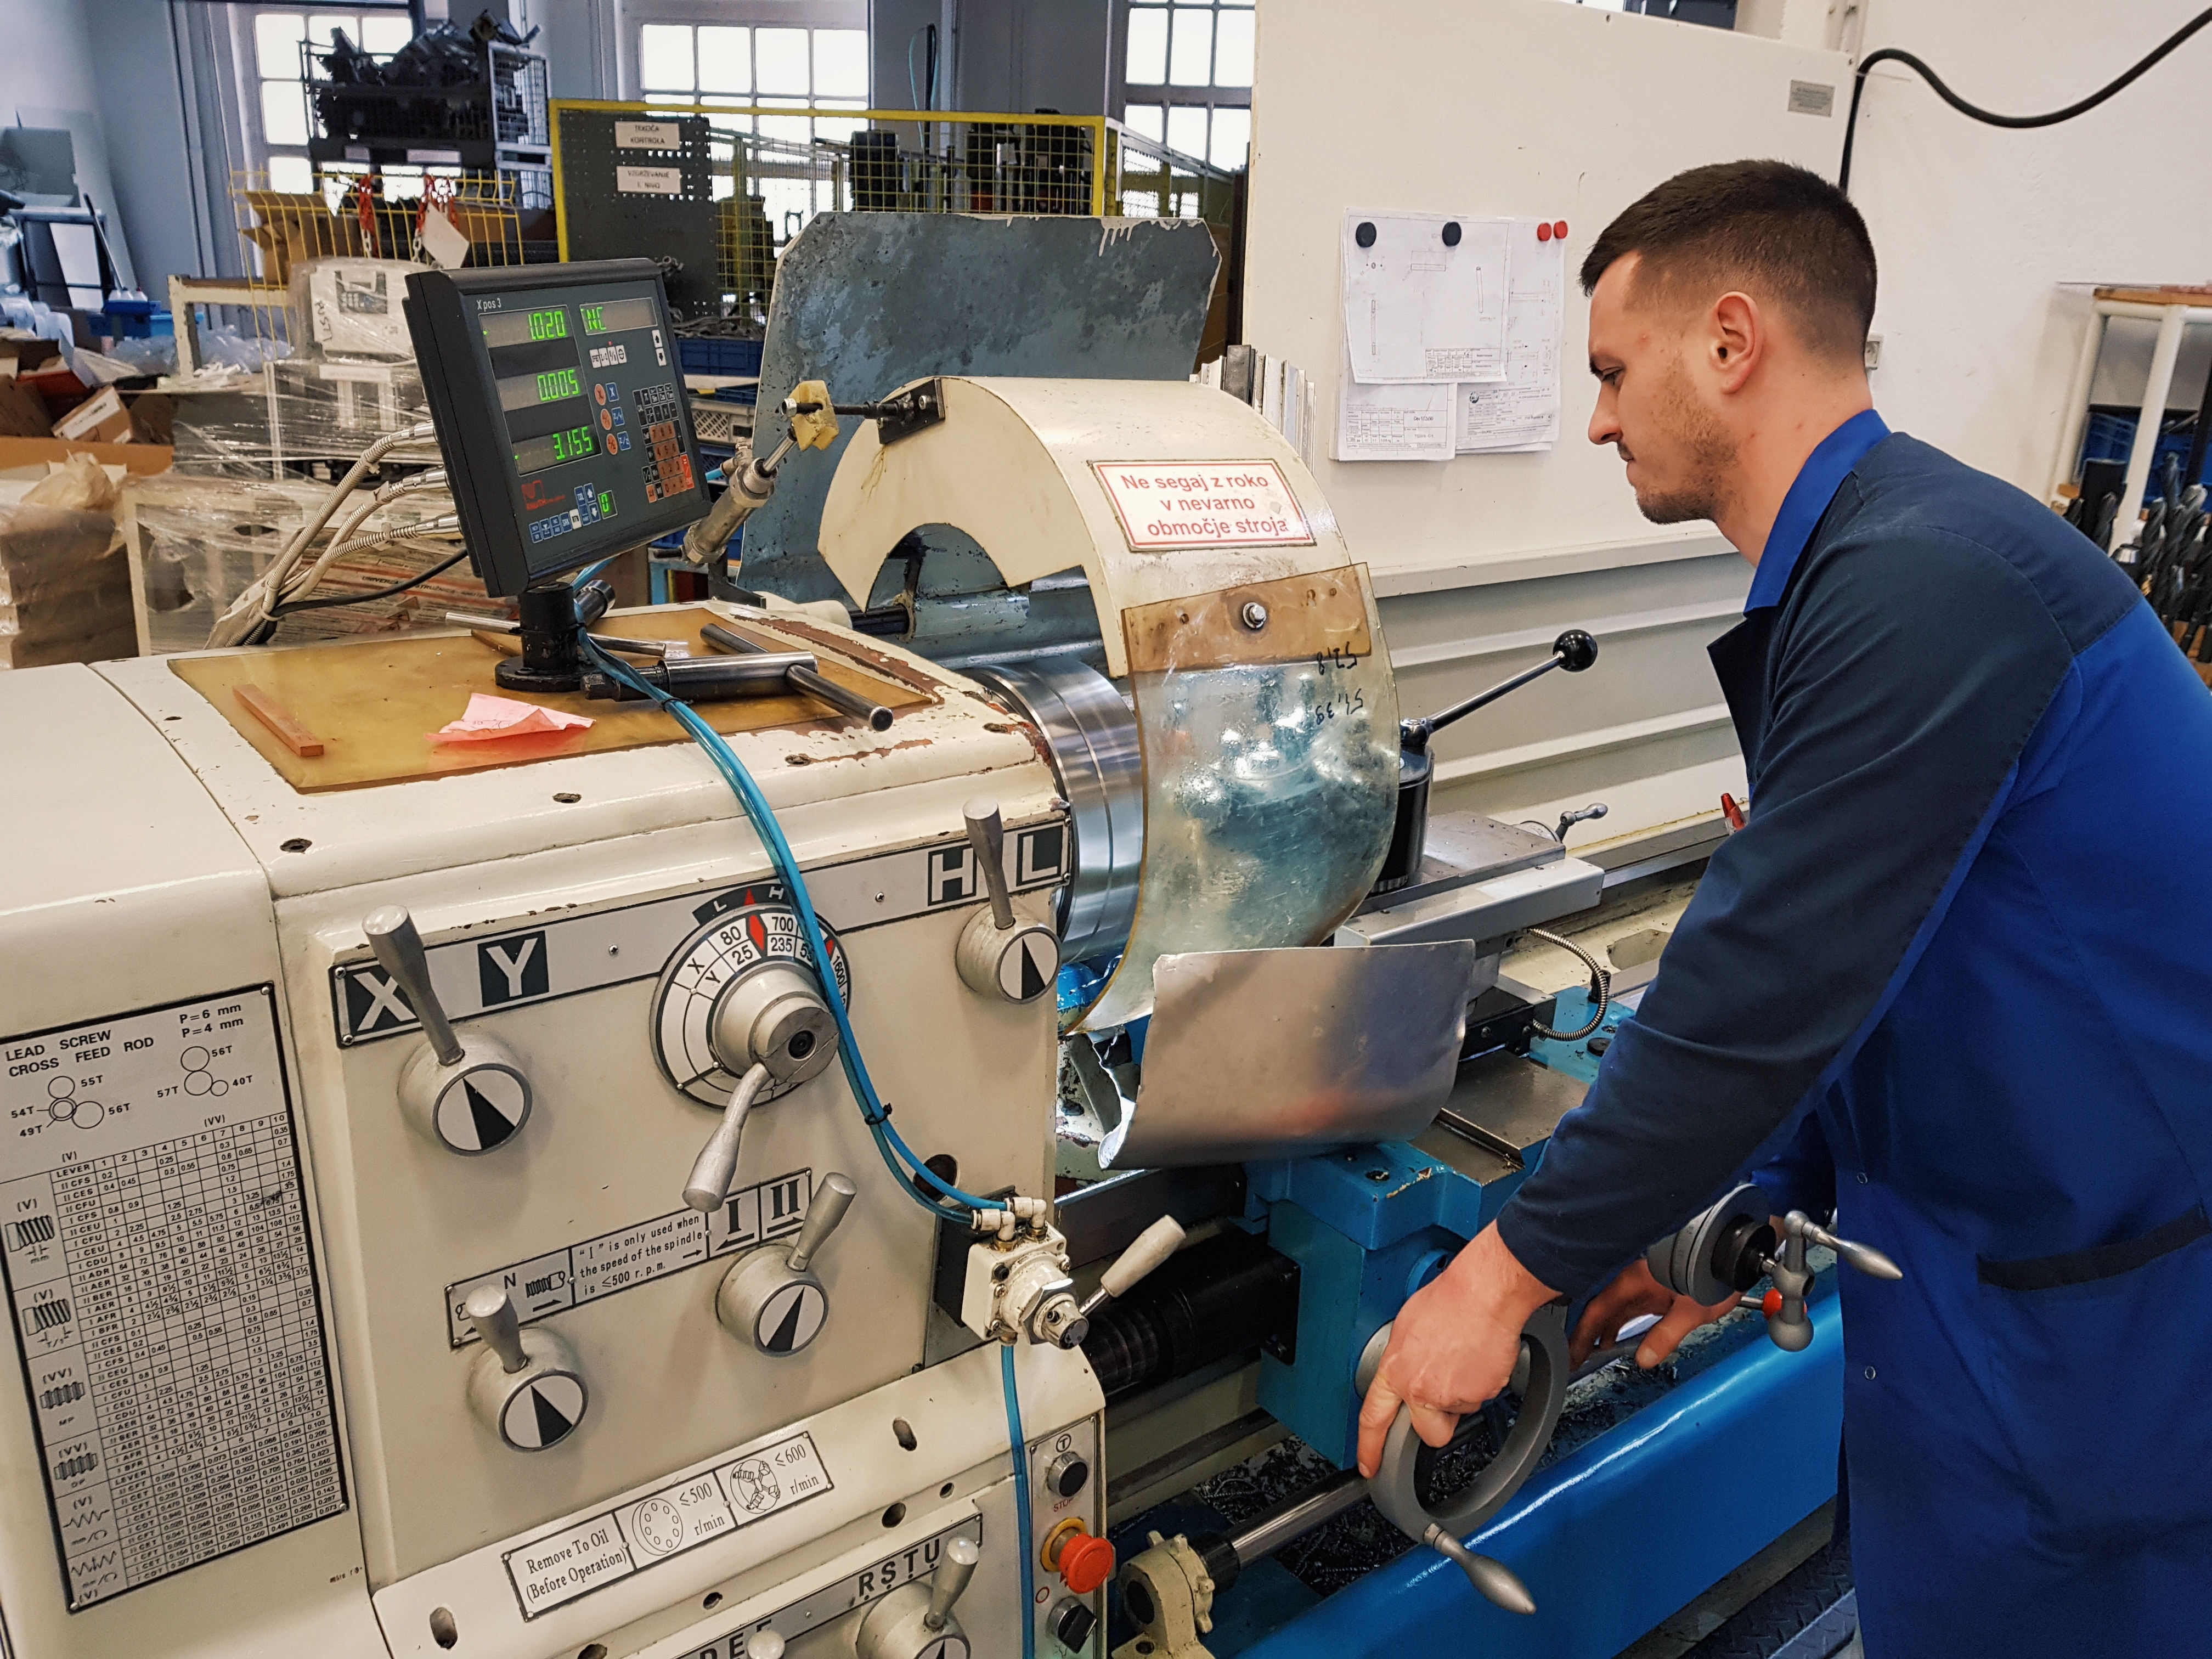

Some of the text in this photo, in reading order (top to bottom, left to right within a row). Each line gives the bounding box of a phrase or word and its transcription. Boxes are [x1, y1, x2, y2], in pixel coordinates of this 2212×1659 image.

[580, 306, 606, 332] NC
[537, 369, 580, 402] 0.005
[1120, 474, 1268, 492] Ne segaj z roko
[1160, 498, 1255, 511] v nevarno
[1148, 517, 1288, 538] območje stroja
[1022, 835, 1058, 882] L
[932, 848, 974, 902] H
[769, 886, 784, 899] H
[713, 900, 727, 912] L
[687, 916, 793, 974] X 80 700
[485, 937, 539, 997] Y
[706, 970, 720, 984] Y
[732, 945, 753, 965] 25
[771, 936, 792, 952] 235
[218, 1005, 241, 1015] mm
[353, 972, 417, 1030] X
[220, 1018, 244, 1029] mm
[5, 1030, 111, 1061] LEAD SCREW
[9, 1037, 154, 1077] CROSS FEED ROD
[212, 1045, 233, 1057] 56T
[81, 1075, 104, 1087] 55T
[157, 1086, 178, 1097] 57T
[233, 1075, 252, 1086] 40T
[12, 1106, 34, 1118] 54T
[109, 1103, 130, 1115] 56T
[204, 1114, 225, 1127] (VV)
[20, 1125, 43, 1137] 49T
[61, 1151, 77, 1163] (V)
[71, 1177, 91, 1187] CFS
[159, 1156, 174, 1165] 0.25
[274, 1126, 288, 1135] 0.35
[57, 1164, 91, 1178] LEVER
[74, 1188, 93, 1199] CES
[121, 1178, 136, 1187] 0.45
[181, 1163, 195, 1171] 0.55
[75, 1200, 95, 1210] CFU
[222, 1164, 235, 1172] 0.75
[770, 1178, 800, 1220] II
[80, 1223, 100, 1233] CEU
[167, 1202, 182, 1210] 1.25
[281, 1170, 295, 1179] 1.75
[77, 1212, 97, 1222] CFS
[82, 1234, 102, 1245] CFU
[129, 1223, 144, 1232] 2.25
[171, 1213, 182, 1221] 2.5
[188, 1207, 202, 1216] 2.75
[726, 1198, 742, 1234] I
[610, 1242, 619, 1251] is
[625, 1233, 645, 1246] only
[652, 1222, 672, 1237] used
[677, 1216, 699, 1229] when
[580, 1231, 702, 1278] the speed of the spindle
[504, 1273, 516, 1289] N
[584, 1285, 595, 1295] is
[790, 1475, 820, 1495] r/min
[695, 1515, 725, 1536] r/min
[526, 1529, 609, 1574] Remove To Oil
[527, 1548, 627, 1604] (Before Operation)
[859, 1539, 939, 1597] R S T U
[729, 1632, 744, 1658] E
